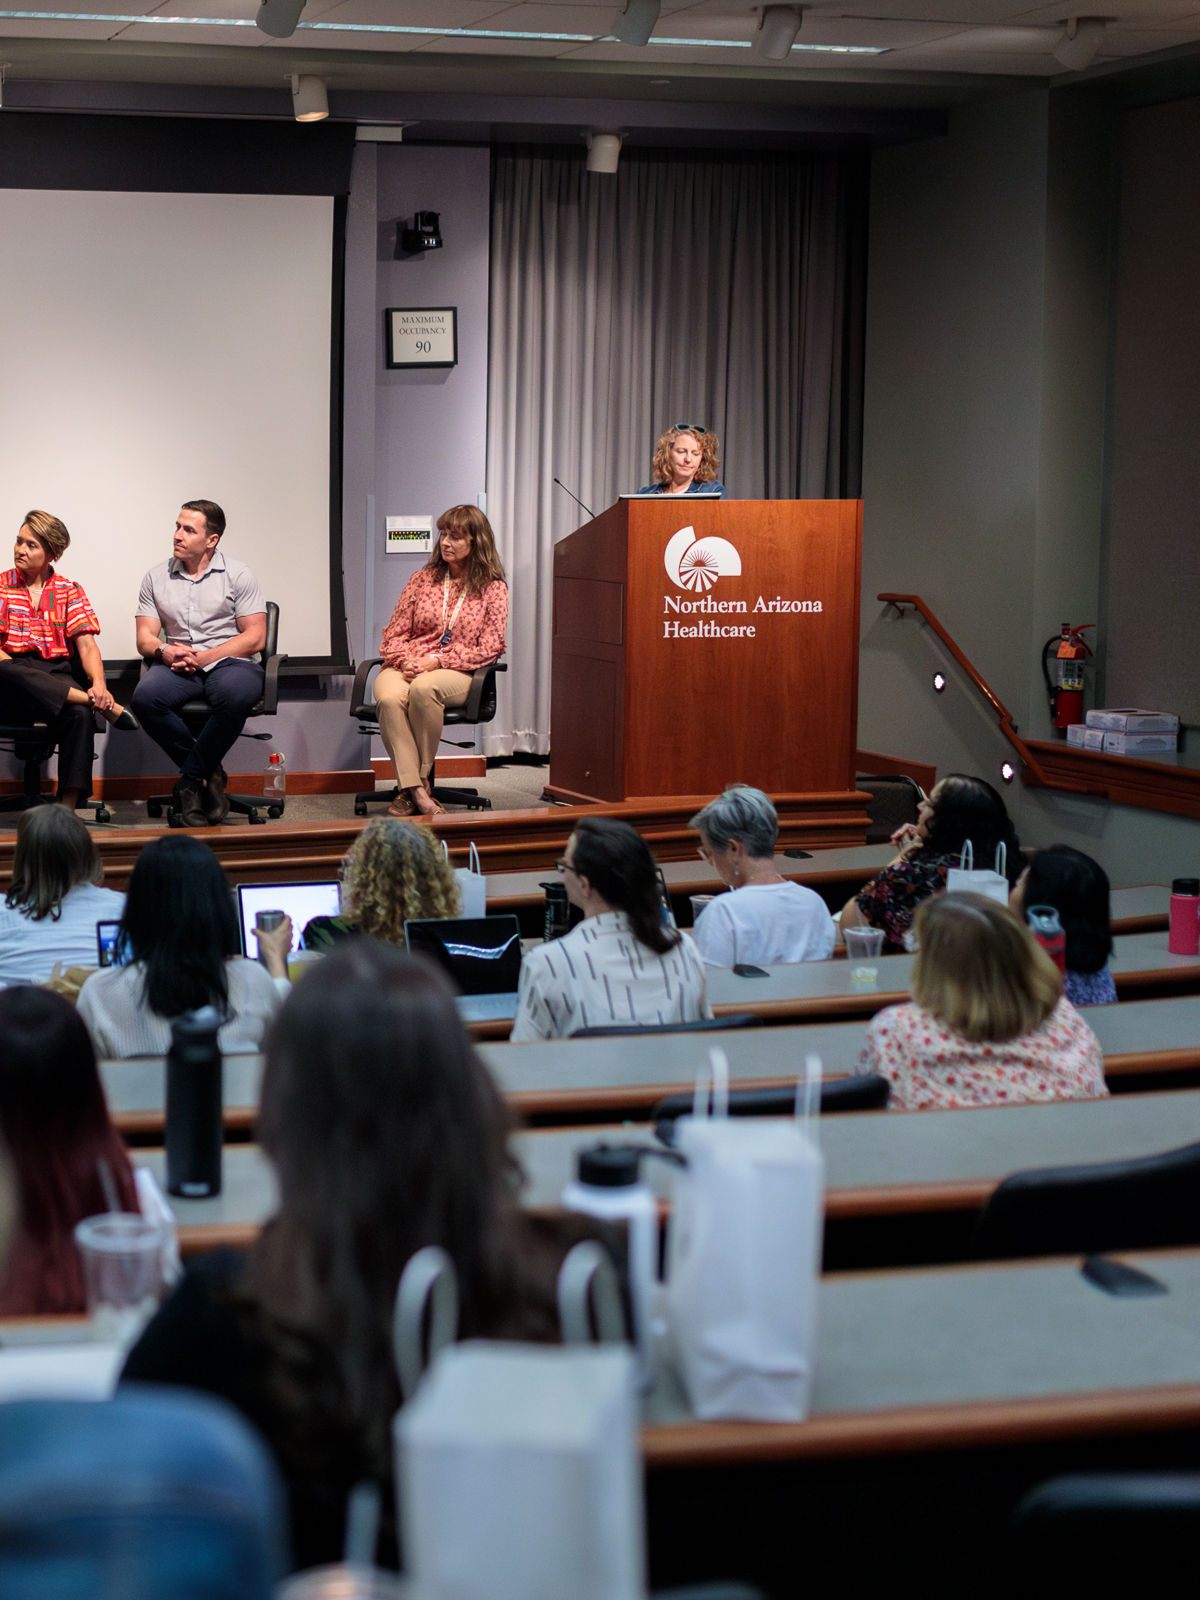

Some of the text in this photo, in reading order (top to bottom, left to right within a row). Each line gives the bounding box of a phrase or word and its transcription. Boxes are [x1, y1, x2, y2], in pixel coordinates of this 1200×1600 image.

[401, 316, 444, 324] MAXIMUM
[399, 327, 446, 335] OCCUPANCY
[415, 340, 432, 354] 90
[663, 594, 823, 614] Northern Arizona
[663, 620, 756, 638] Healthcare
